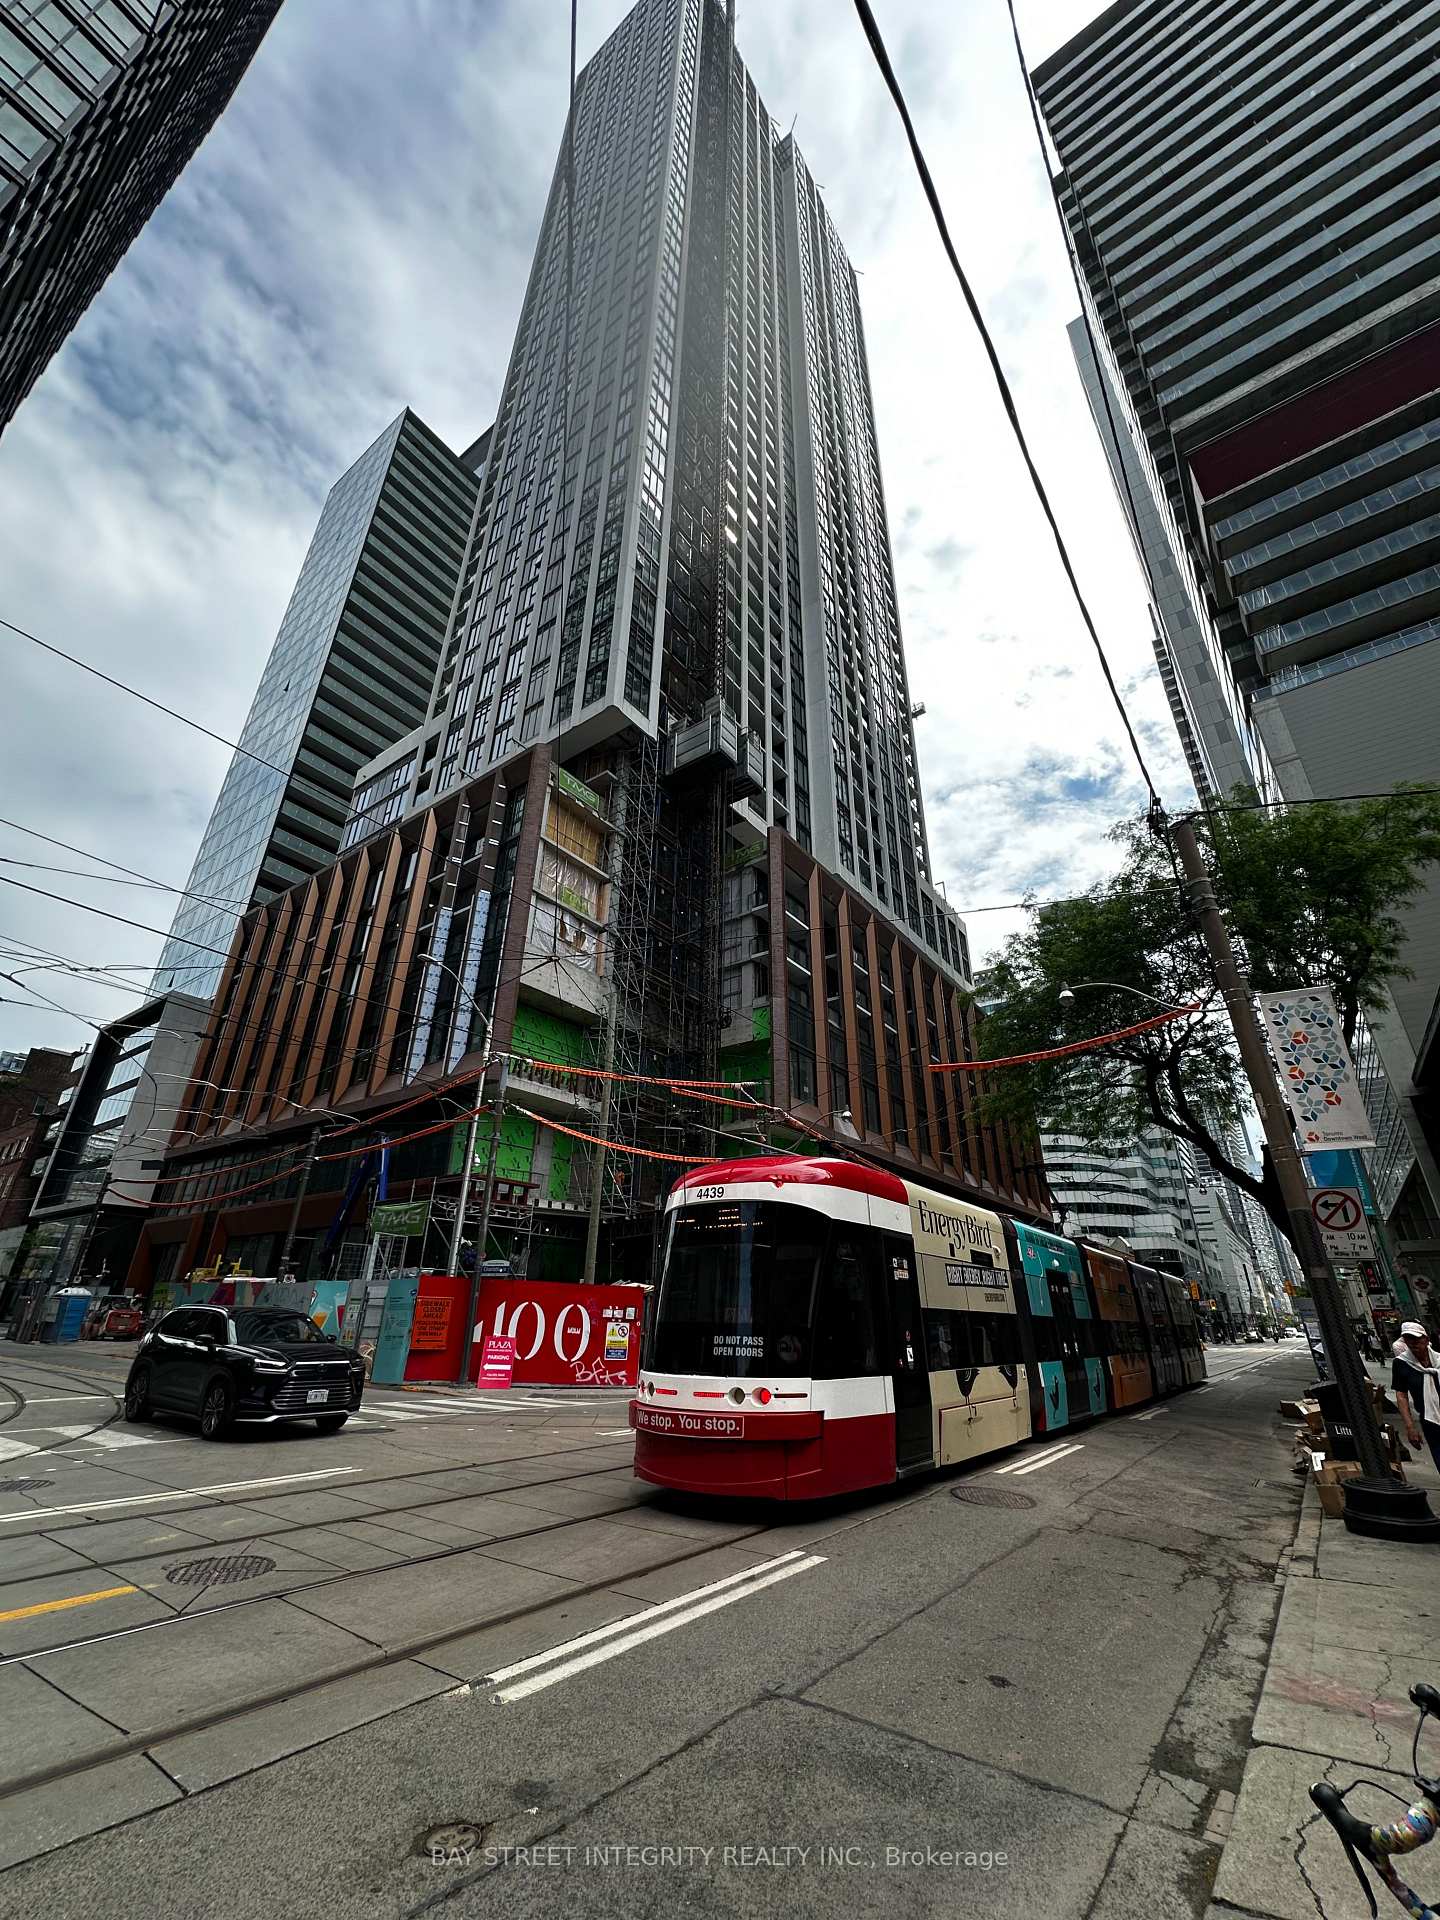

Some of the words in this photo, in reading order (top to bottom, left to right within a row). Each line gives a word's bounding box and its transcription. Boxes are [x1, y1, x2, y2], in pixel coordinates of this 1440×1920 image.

[563, 773, 596, 802] TMG
[696, 1186, 725, 1199] 4439
[378, 1210, 420, 1226] TMG
[918, 1200, 992, 1250] EnergyBird
[1346, 1232, 1356, 1241] 10
[1350, 1243, 1356, 1251] 7
[488, 1340, 512, 1349] PLAZA
[714, 1335, 724, 1344] DO
[725, 1335, 741, 1345] NOT
[742, 1336, 764, 1346] PASS
[713, 1346, 733, 1356] OPEN
[735, 1347, 764, 1358] DOORS
[638, 1410, 649, 1425] We
[650, 1413, 675, 1431] stop.
[678, 1414, 701, 1430] You
[704, 1416, 741, 1434] stop.
